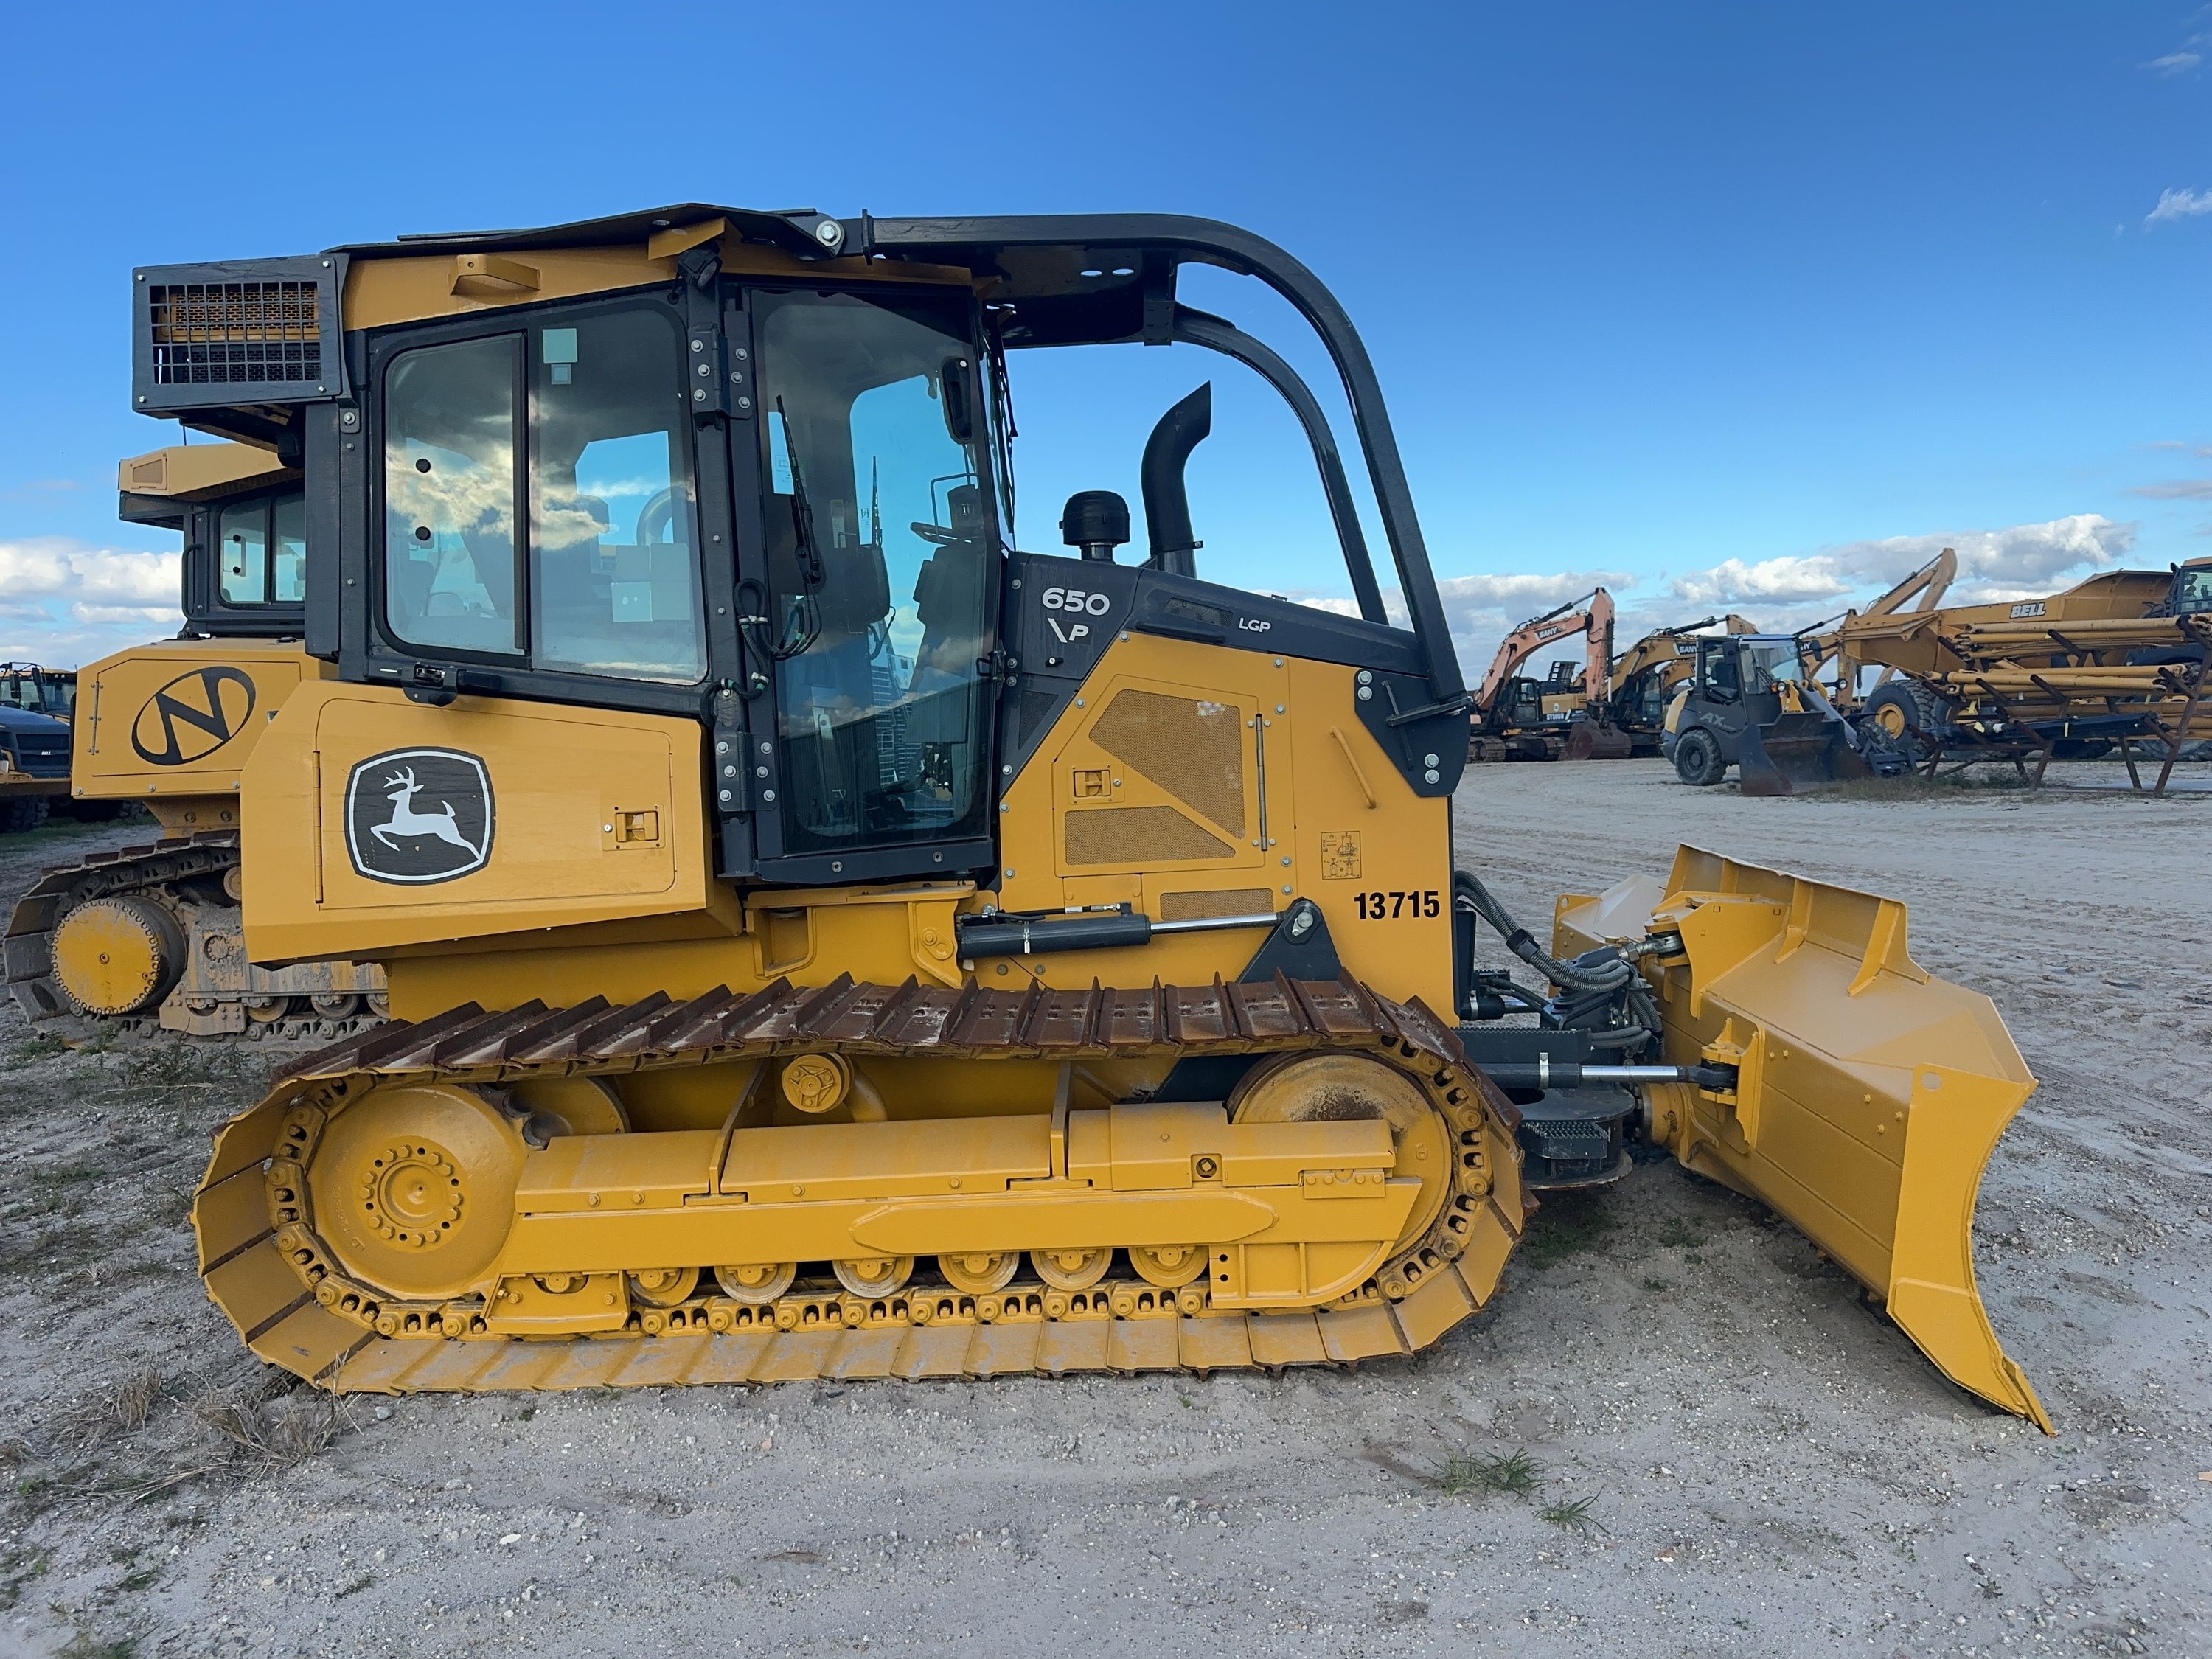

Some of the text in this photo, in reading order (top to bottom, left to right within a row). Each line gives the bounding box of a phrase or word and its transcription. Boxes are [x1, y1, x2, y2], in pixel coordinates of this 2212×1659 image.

[1042, 587, 1110, 616] 650
[2011, 602, 2045, 619] BELL
[1239, 617, 1271, 633] LGP
[1539, 627, 1557, 639] SANY
[1354, 890, 1440, 920] 13715
